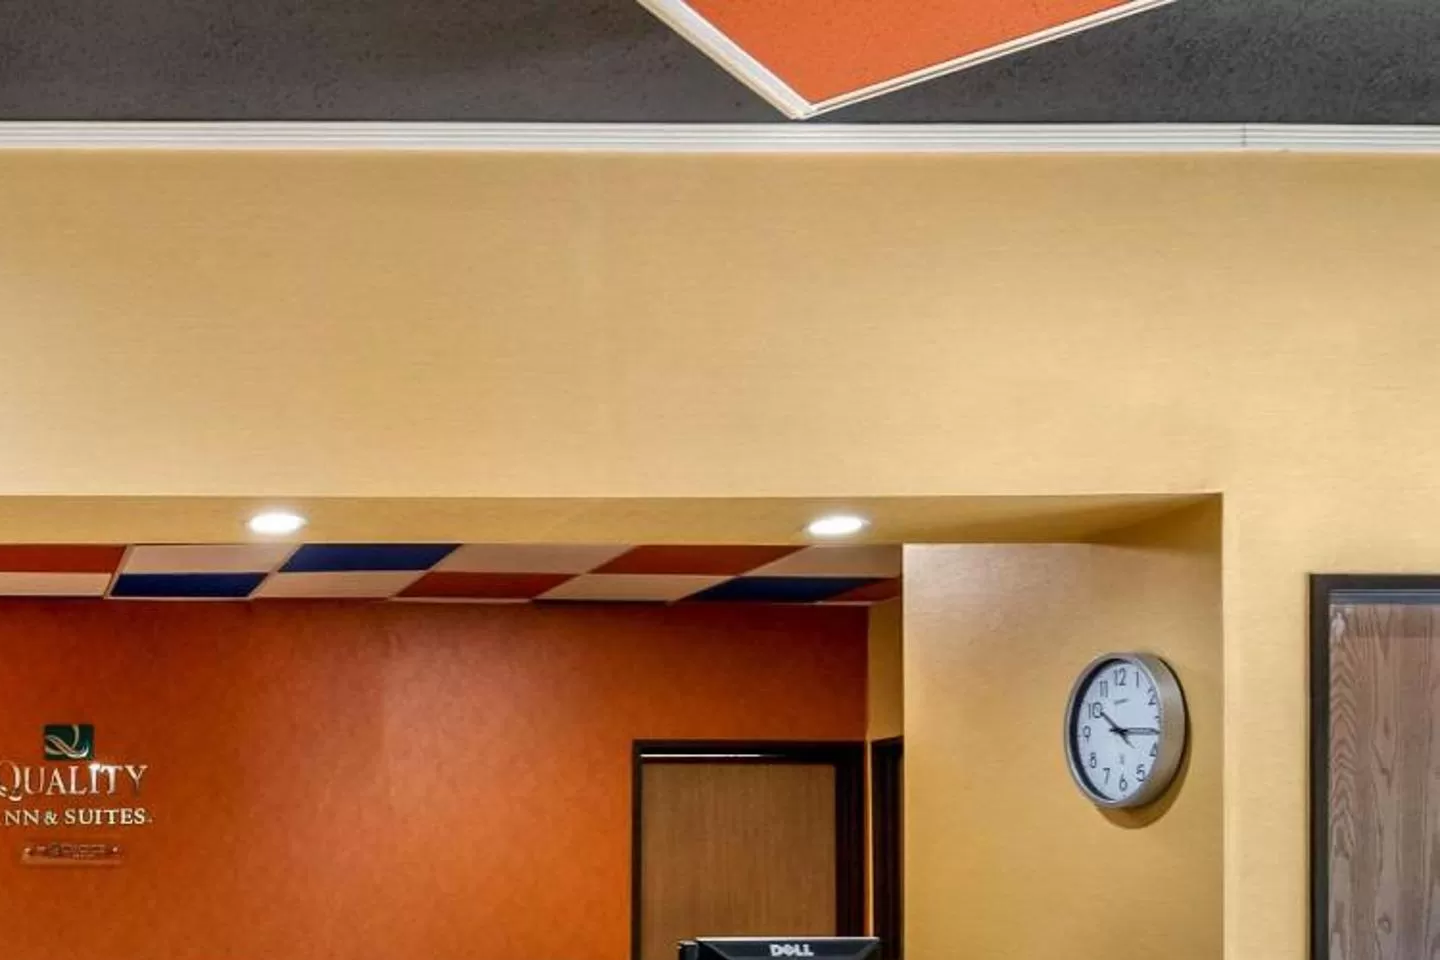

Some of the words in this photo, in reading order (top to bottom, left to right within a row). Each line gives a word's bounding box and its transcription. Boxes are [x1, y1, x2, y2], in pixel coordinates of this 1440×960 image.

[1113, 668, 1127, 686] 12
[1099, 680, 1109, 698] 11
[1147, 687, 1157, 705] 2
[1088, 702, 1103, 719] 10
[1082, 725, 1091, 742] 9
[1149, 743, 1158, 757] 4
[1089, 752, 1097, 768] 8
[1103, 767, 1111, 784] 7
[1136, 763, 1146, 782] 5
[1119, 774, 1128, 791] 6
[44, 809, 59, 826] &
[65, 808, 146, 826] SUITES
[769, 943, 814, 957] DELL
